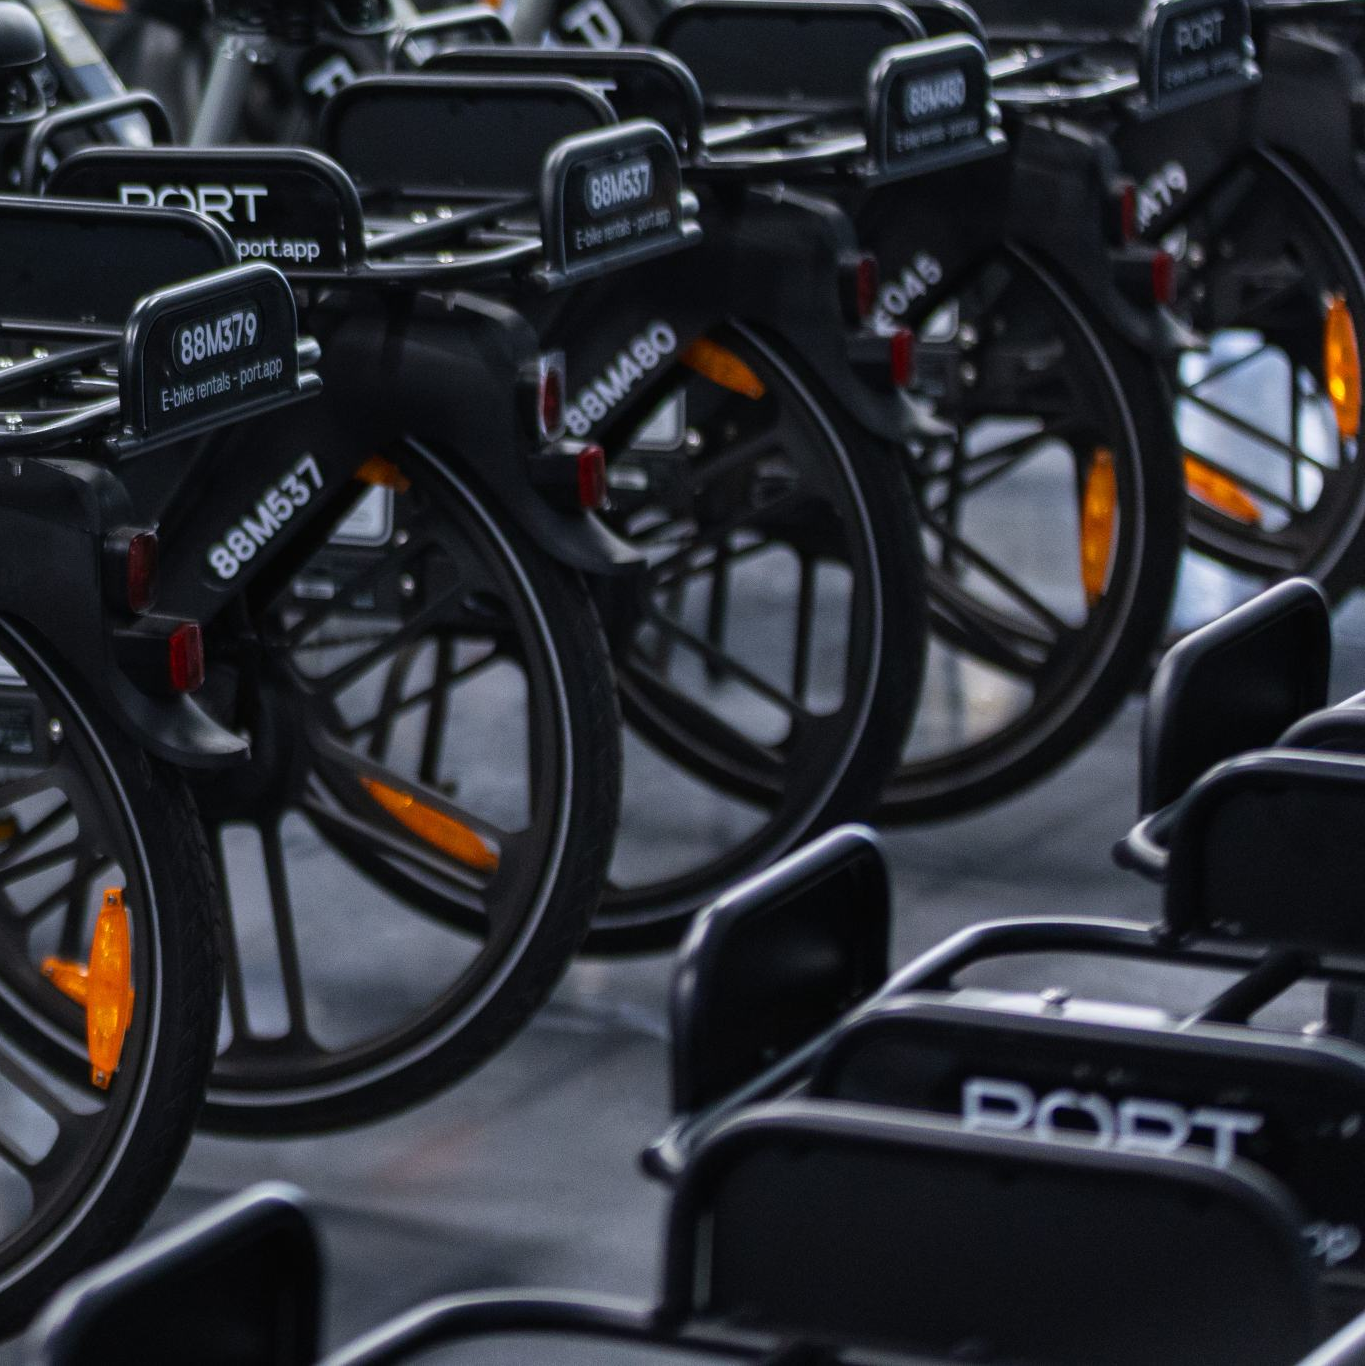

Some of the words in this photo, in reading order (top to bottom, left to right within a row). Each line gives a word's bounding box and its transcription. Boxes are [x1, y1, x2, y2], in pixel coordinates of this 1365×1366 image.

[121, 186, 268, 222] PORT
[591, 162, 651, 210] 88M537
[237, 237, 319, 262] port.app
[181, 313, 257, 365] 88M379
[162, 387, 194, 411] E-bike
[197, 372, 230, 400] rentals
[240, 358, 282, 390] port.app
[565, 322, 677, 436] 88M480
[210, 455, 323, 579] 88M537
